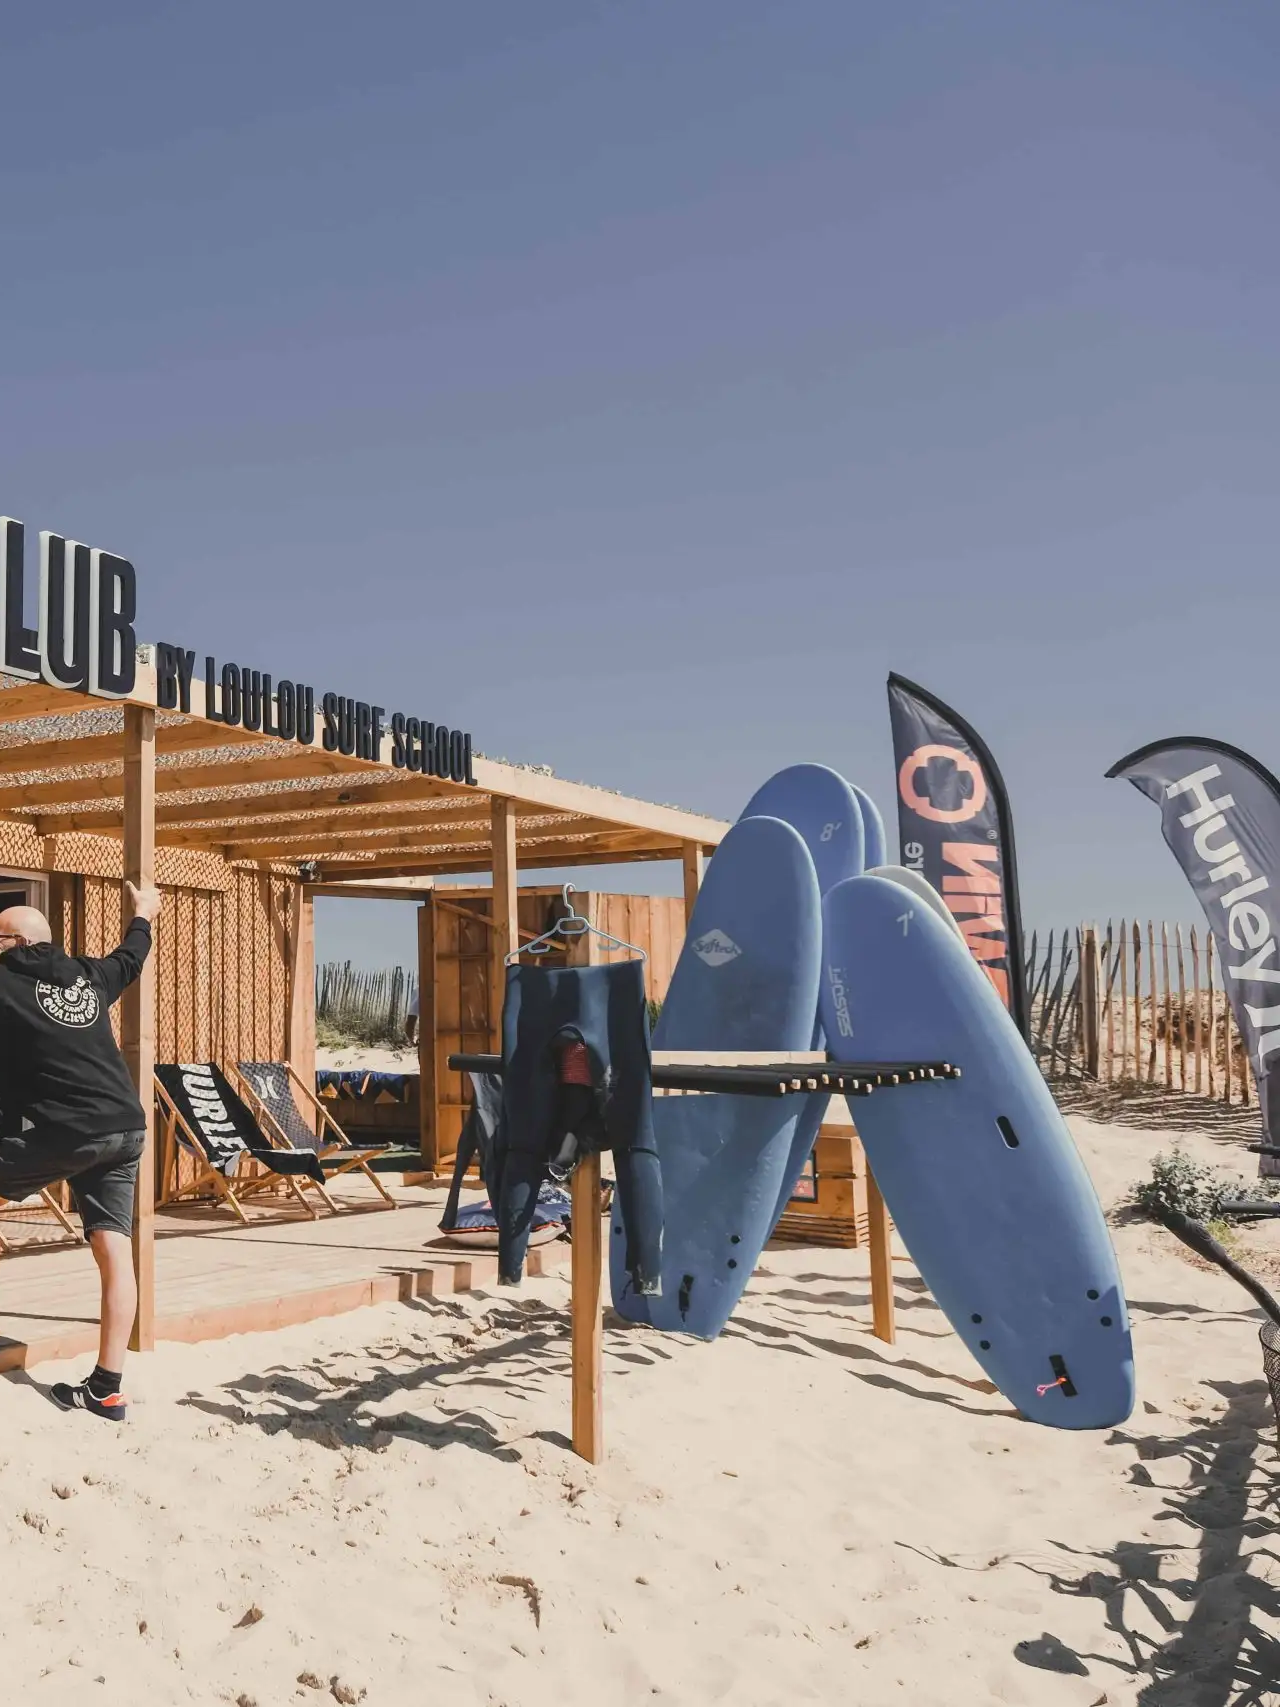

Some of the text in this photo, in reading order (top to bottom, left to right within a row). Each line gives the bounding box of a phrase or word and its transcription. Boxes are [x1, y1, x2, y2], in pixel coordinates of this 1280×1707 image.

[156, 642, 478, 786] BY LOULOU SURF SCHOOL
[1166, 763, 1280, 983] Hurley
